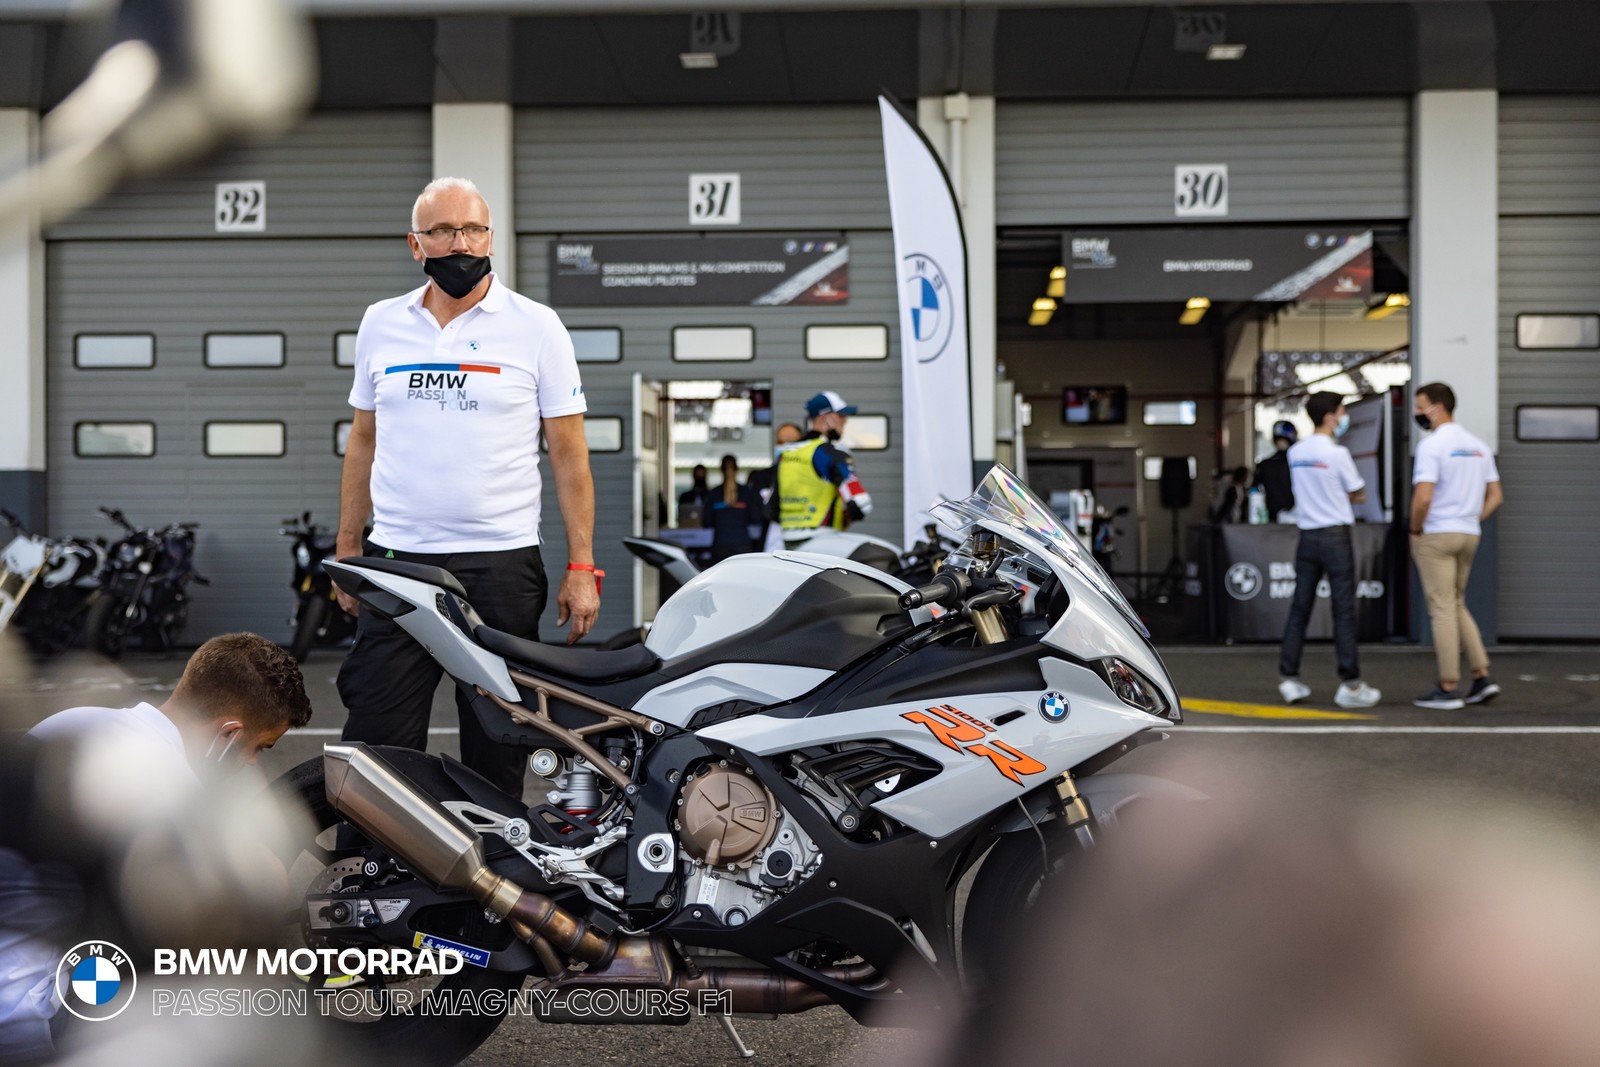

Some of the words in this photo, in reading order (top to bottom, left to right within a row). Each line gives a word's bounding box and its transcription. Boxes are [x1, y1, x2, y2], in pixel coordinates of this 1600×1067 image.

[695, 181, 732, 217] 31
[1178, 172, 1223, 208] 30
[219, 189, 260, 224] 32
[408, 373, 468, 389] BMW
[1043, 692, 1069, 704] BMW
[940, 704, 997, 733] S1000
[899, 707, 1048, 789] RR
[742, 810, 762, 818] BMW
